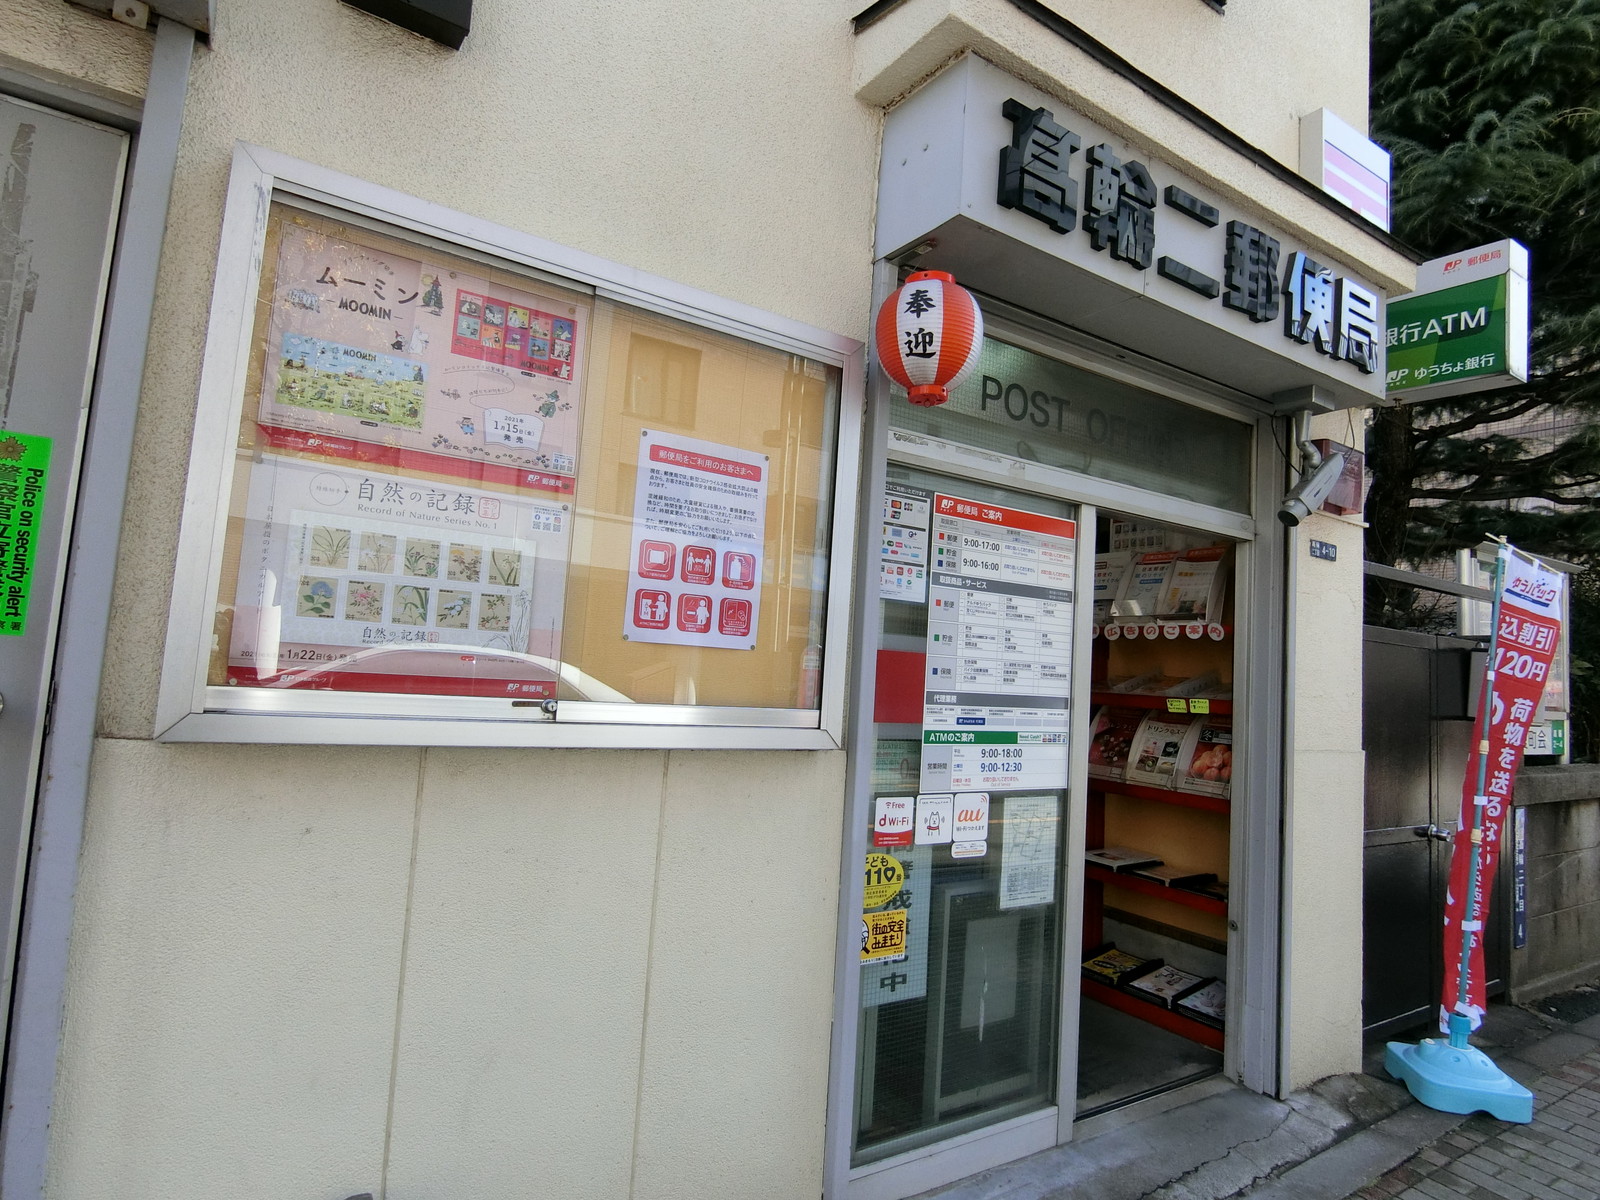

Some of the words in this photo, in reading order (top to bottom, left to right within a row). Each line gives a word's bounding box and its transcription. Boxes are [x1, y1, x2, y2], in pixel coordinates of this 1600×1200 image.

[997, 98, 1379, 374] 高輪二郵便局
[1468, 250, 1502, 267] 郵便局
[316, 266, 419, 305] ムーミン
[338, 297, 392, 321] MOOMIN
[903, 288, 937, 360] 奉迎
[342, 348, 377, 363] MOOMIN
[519, 359, 550, 374] MOOMIN
[1415, 353, 1495, 380] ゆうちょ銀行
[980, 375, 1071, 434] POST
[504, 415, 524, 424] 2021年
[493, 420, 535, 437] 1月15日(金)
[503, 433, 524, 444] 発売
[658, 449, 755, 476] 郵便局をご利用のお客さまへ
[22, 468, 44, 508] Police
[358, 478, 475, 515] 自然の記録
[20, 509, 34, 527] on
[357, 503, 392, 516] Record
[409, 511, 441, 522] Nature
[444, 515, 471, 527] Series
[475, 520, 490, 529] No.
[956, 504, 978, 517] 郵便局
[982, 508, 1003, 522] ご案内
[946, 534, 958, 543] 郵便
[963, 538, 1000, 552] 9:00-17:00
[6, 530, 31, 584] security
[945, 548, 957, 557] 貯金
[1321, 546, 1336, 557] 4-10
[962, 558, 1000, 572] 9:00-16:00
[939, 575, 987, 589] 取扱商品・サービス
[1512, 576, 1557, 603] ゆうパック
[5, 586, 25, 618] alert
[943, 600, 954, 609] 郵便
[362, 626, 427, 642] 自然の記録
[942, 634, 953, 643] 貯金
[1499, 615, 1554, 651] 込割引
[287, 648, 337, 662] 1月22日(金)
[940, 668, 952, 677] 保険
[1495, 647, 1546, 682] 120円
[934, 694, 957, 704] 代理業務
[929, 733, 975, 743] ATMのご案内
[981, 748, 1023, 759] 9:00-18:00
[927, 762, 948, 771] 営業時間
[980, 762, 1023, 773] 9:00-12:30
[879, 814, 887, 827] d
[888, 817, 909, 827] Wi-Fi
[957, 808, 985, 823] au
[871, 920, 905, 935] 街の安全
[871, 934, 903, 950] みまもり
